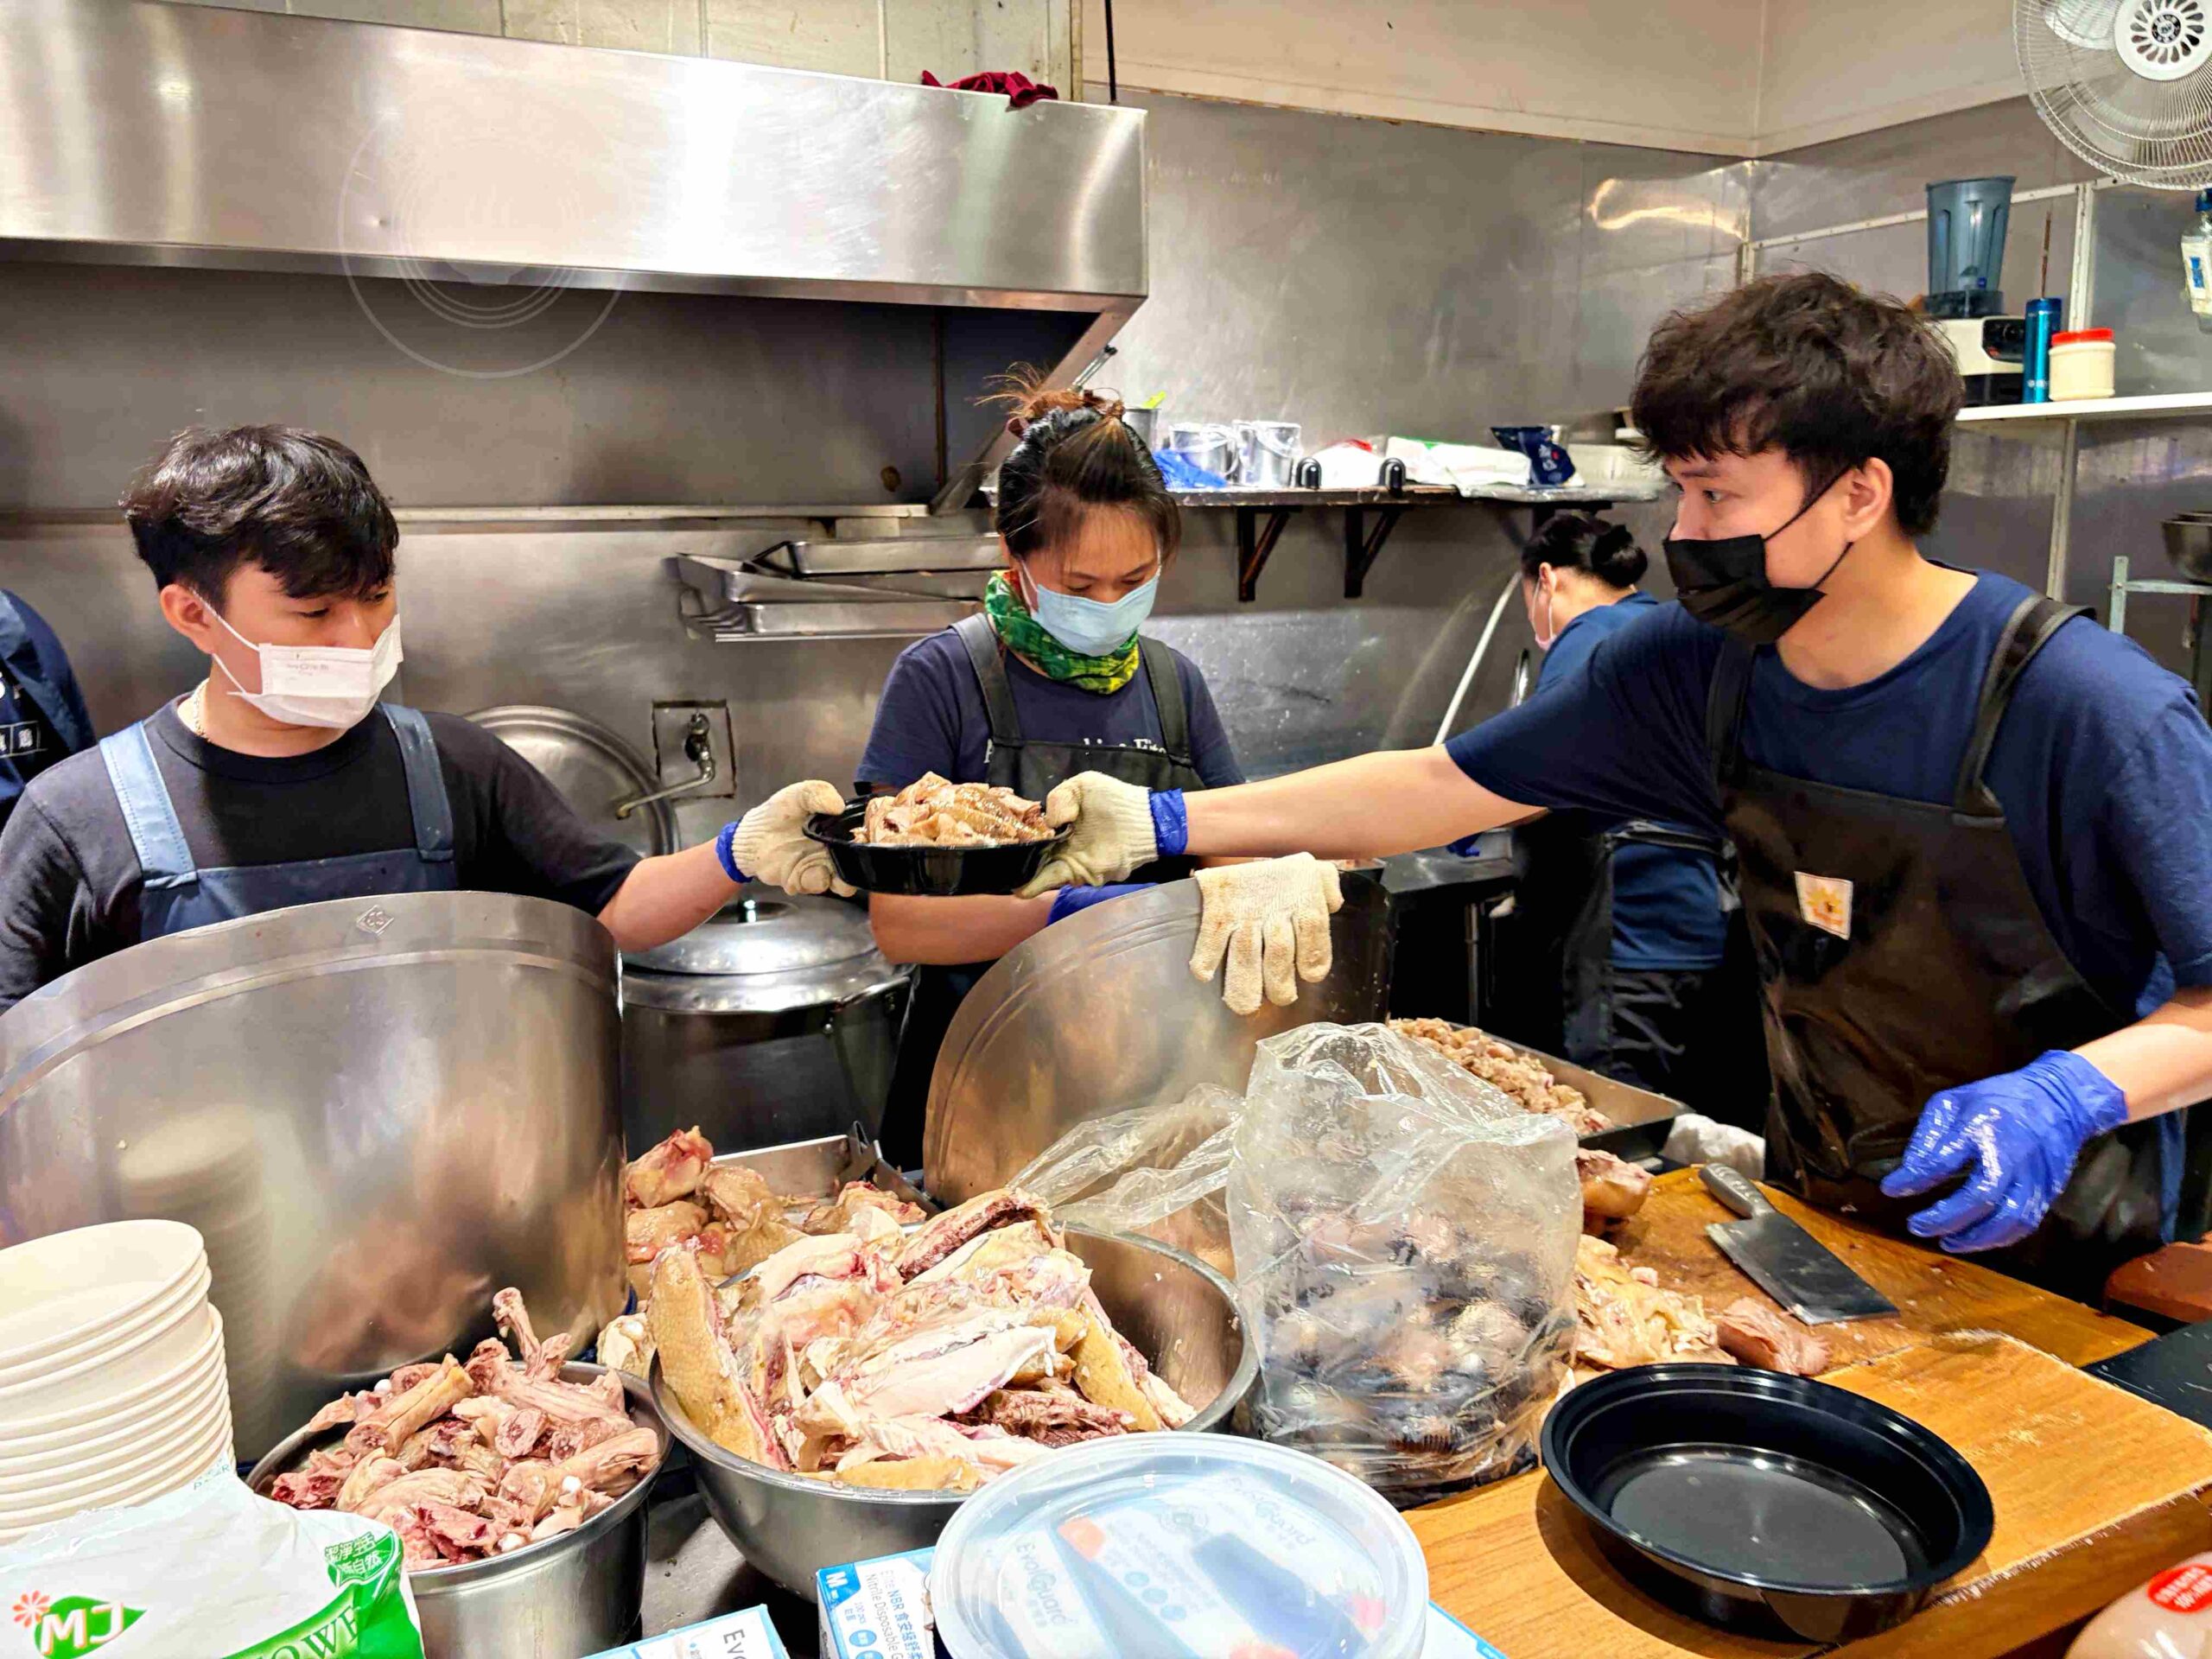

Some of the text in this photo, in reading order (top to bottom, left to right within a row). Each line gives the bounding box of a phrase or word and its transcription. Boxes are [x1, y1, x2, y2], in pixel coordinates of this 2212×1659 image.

[826, 1572, 849, 1589] M
[40, 1601, 124, 1656] MJ
[874, 1601, 900, 1651] Disposable
